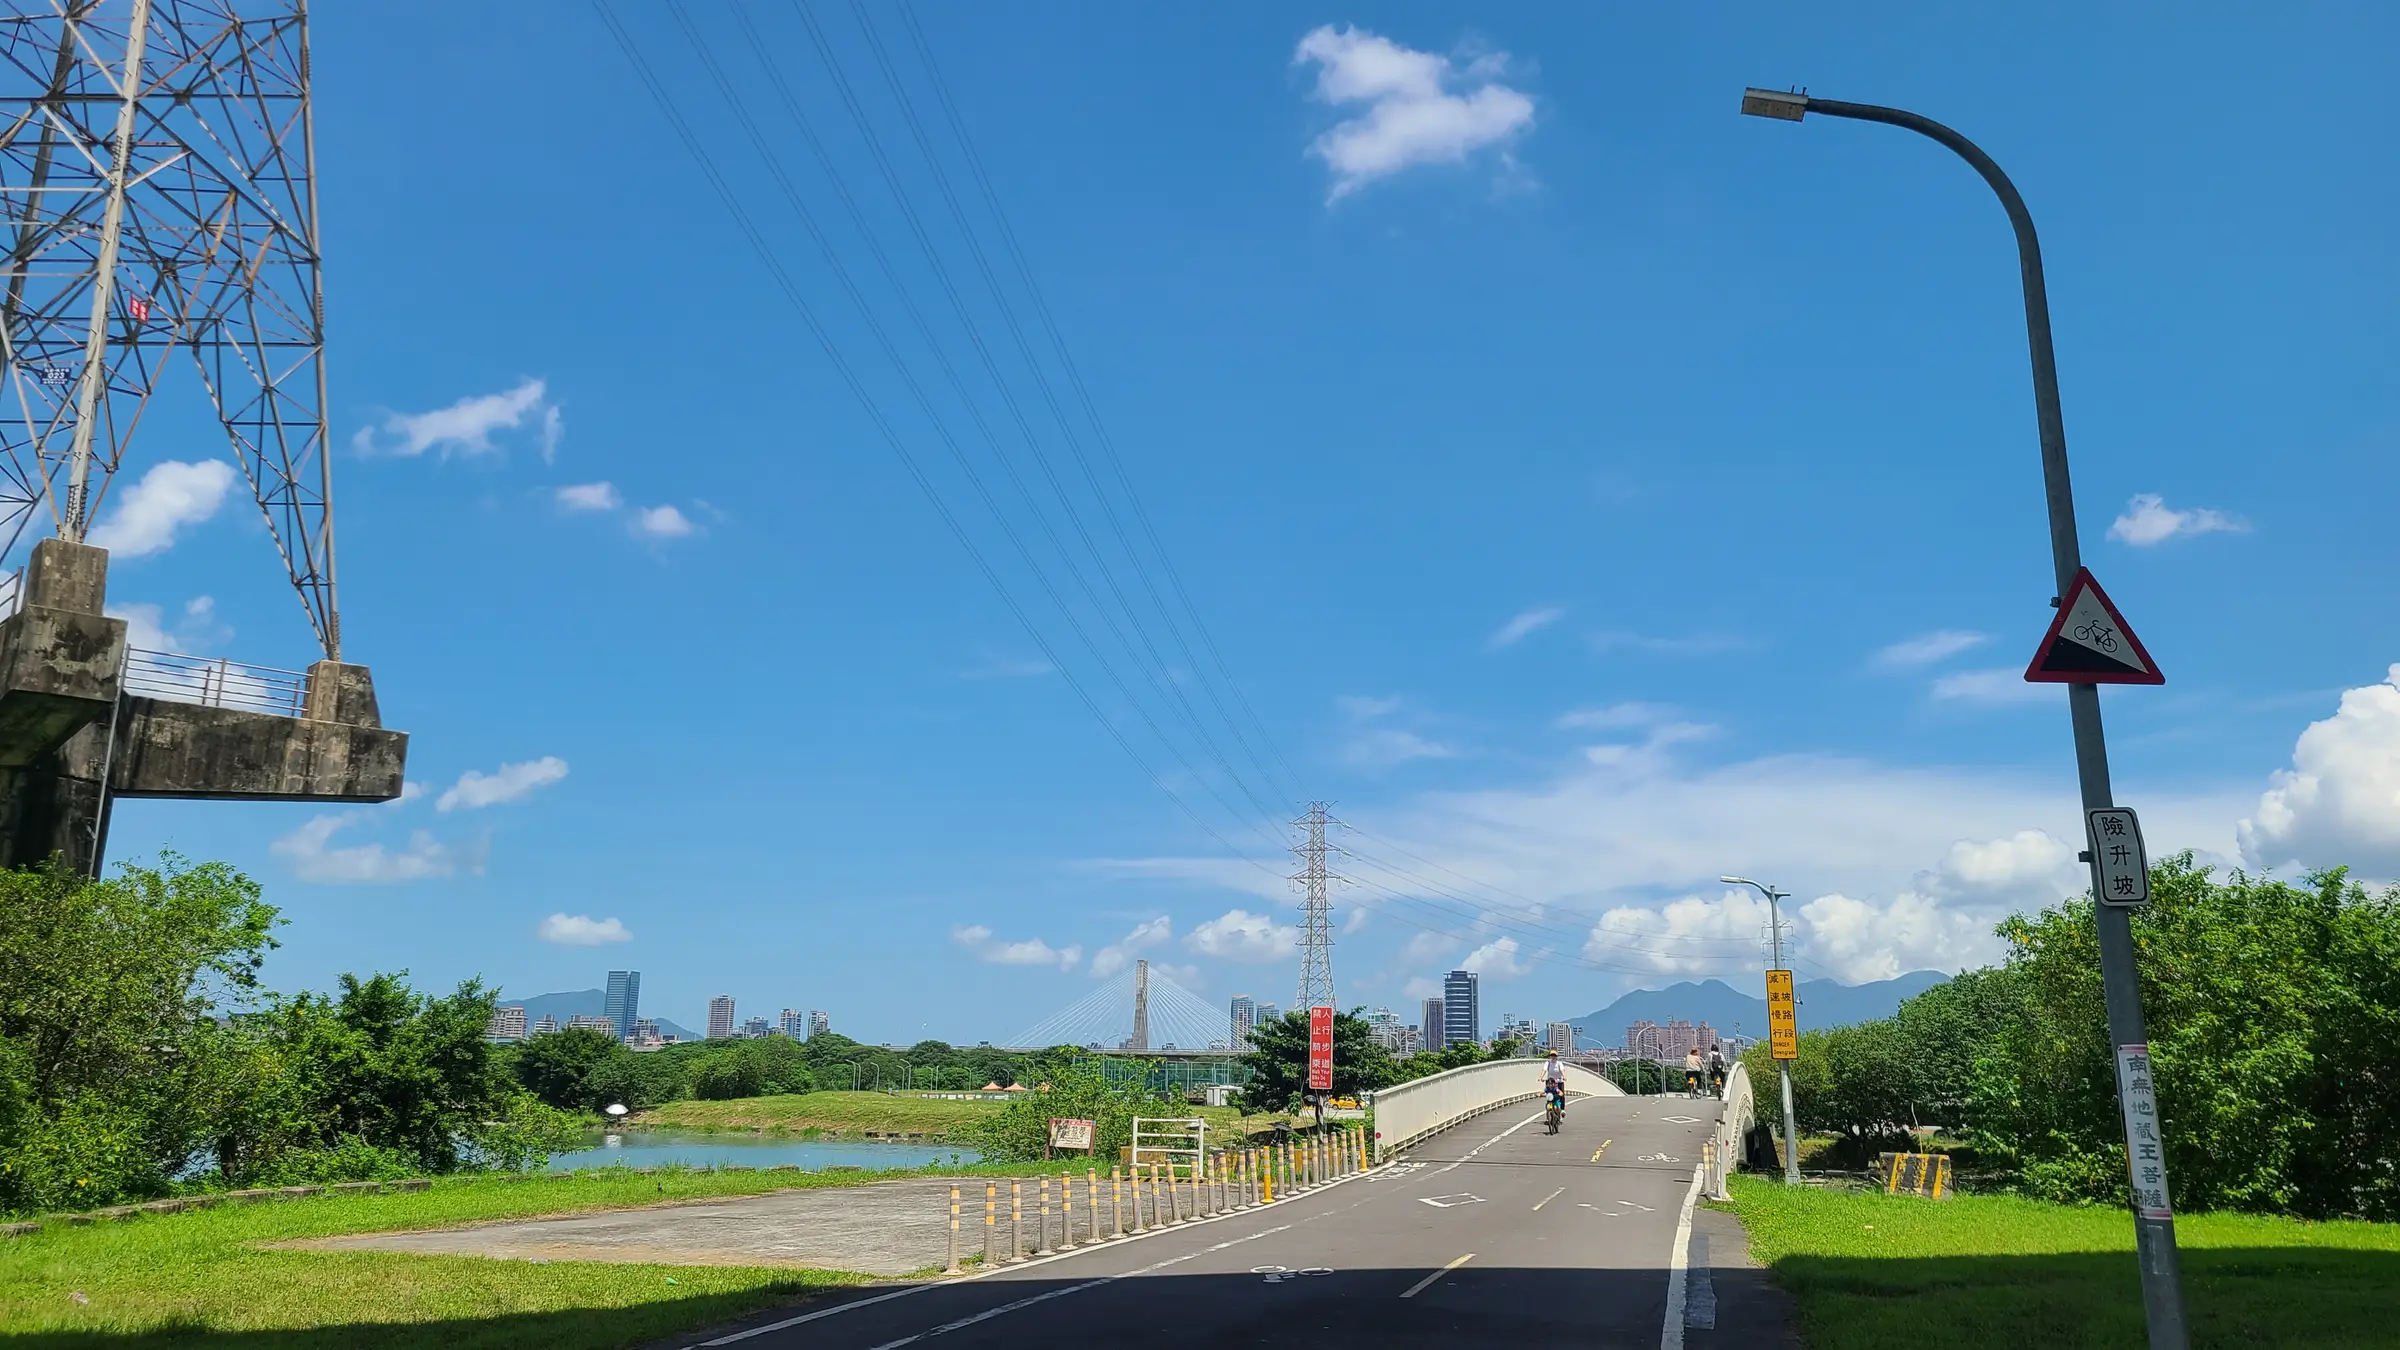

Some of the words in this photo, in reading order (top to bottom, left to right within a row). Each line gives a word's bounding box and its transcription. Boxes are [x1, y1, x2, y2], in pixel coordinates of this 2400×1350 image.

[2101, 816, 2135, 895] 險升坡
[1768, 974, 1782, 1038] 減速慢行
[1779, 974, 1794, 1038] 下坡路段
[1312, 1009, 1321, 1069] 禁止騎乘
[1322, 1009, 1331, 1069] 人行步道
[2127, 1055, 2166, 1208] 南無地藏王菩薩
